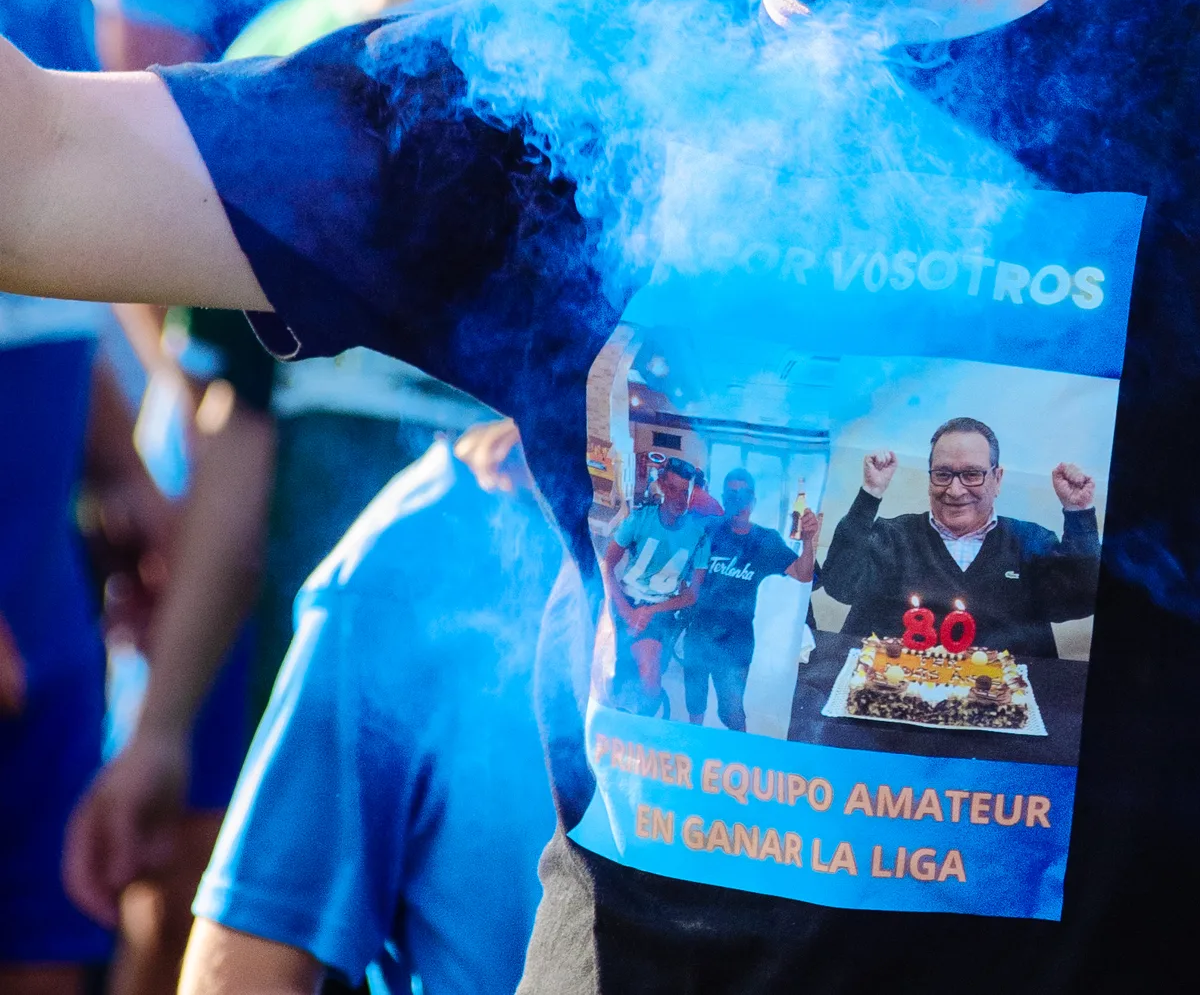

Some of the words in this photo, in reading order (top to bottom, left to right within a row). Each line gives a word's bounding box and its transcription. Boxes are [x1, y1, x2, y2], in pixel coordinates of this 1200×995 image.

[830, 249, 1106, 310] VOSOTROS
[902, 608, 976, 654] 80
[594, 733, 693, 790] PRIMER
[701, 759, 832, 811] EQUIPO
[843, 782, 1051, 828] AMATEUR
[635, 804, 675, 843] EN
[682, 815, 803, 867] GANAR
[811, 838, 858, 876] LA
[871, 845, 967, 883] LIGA
